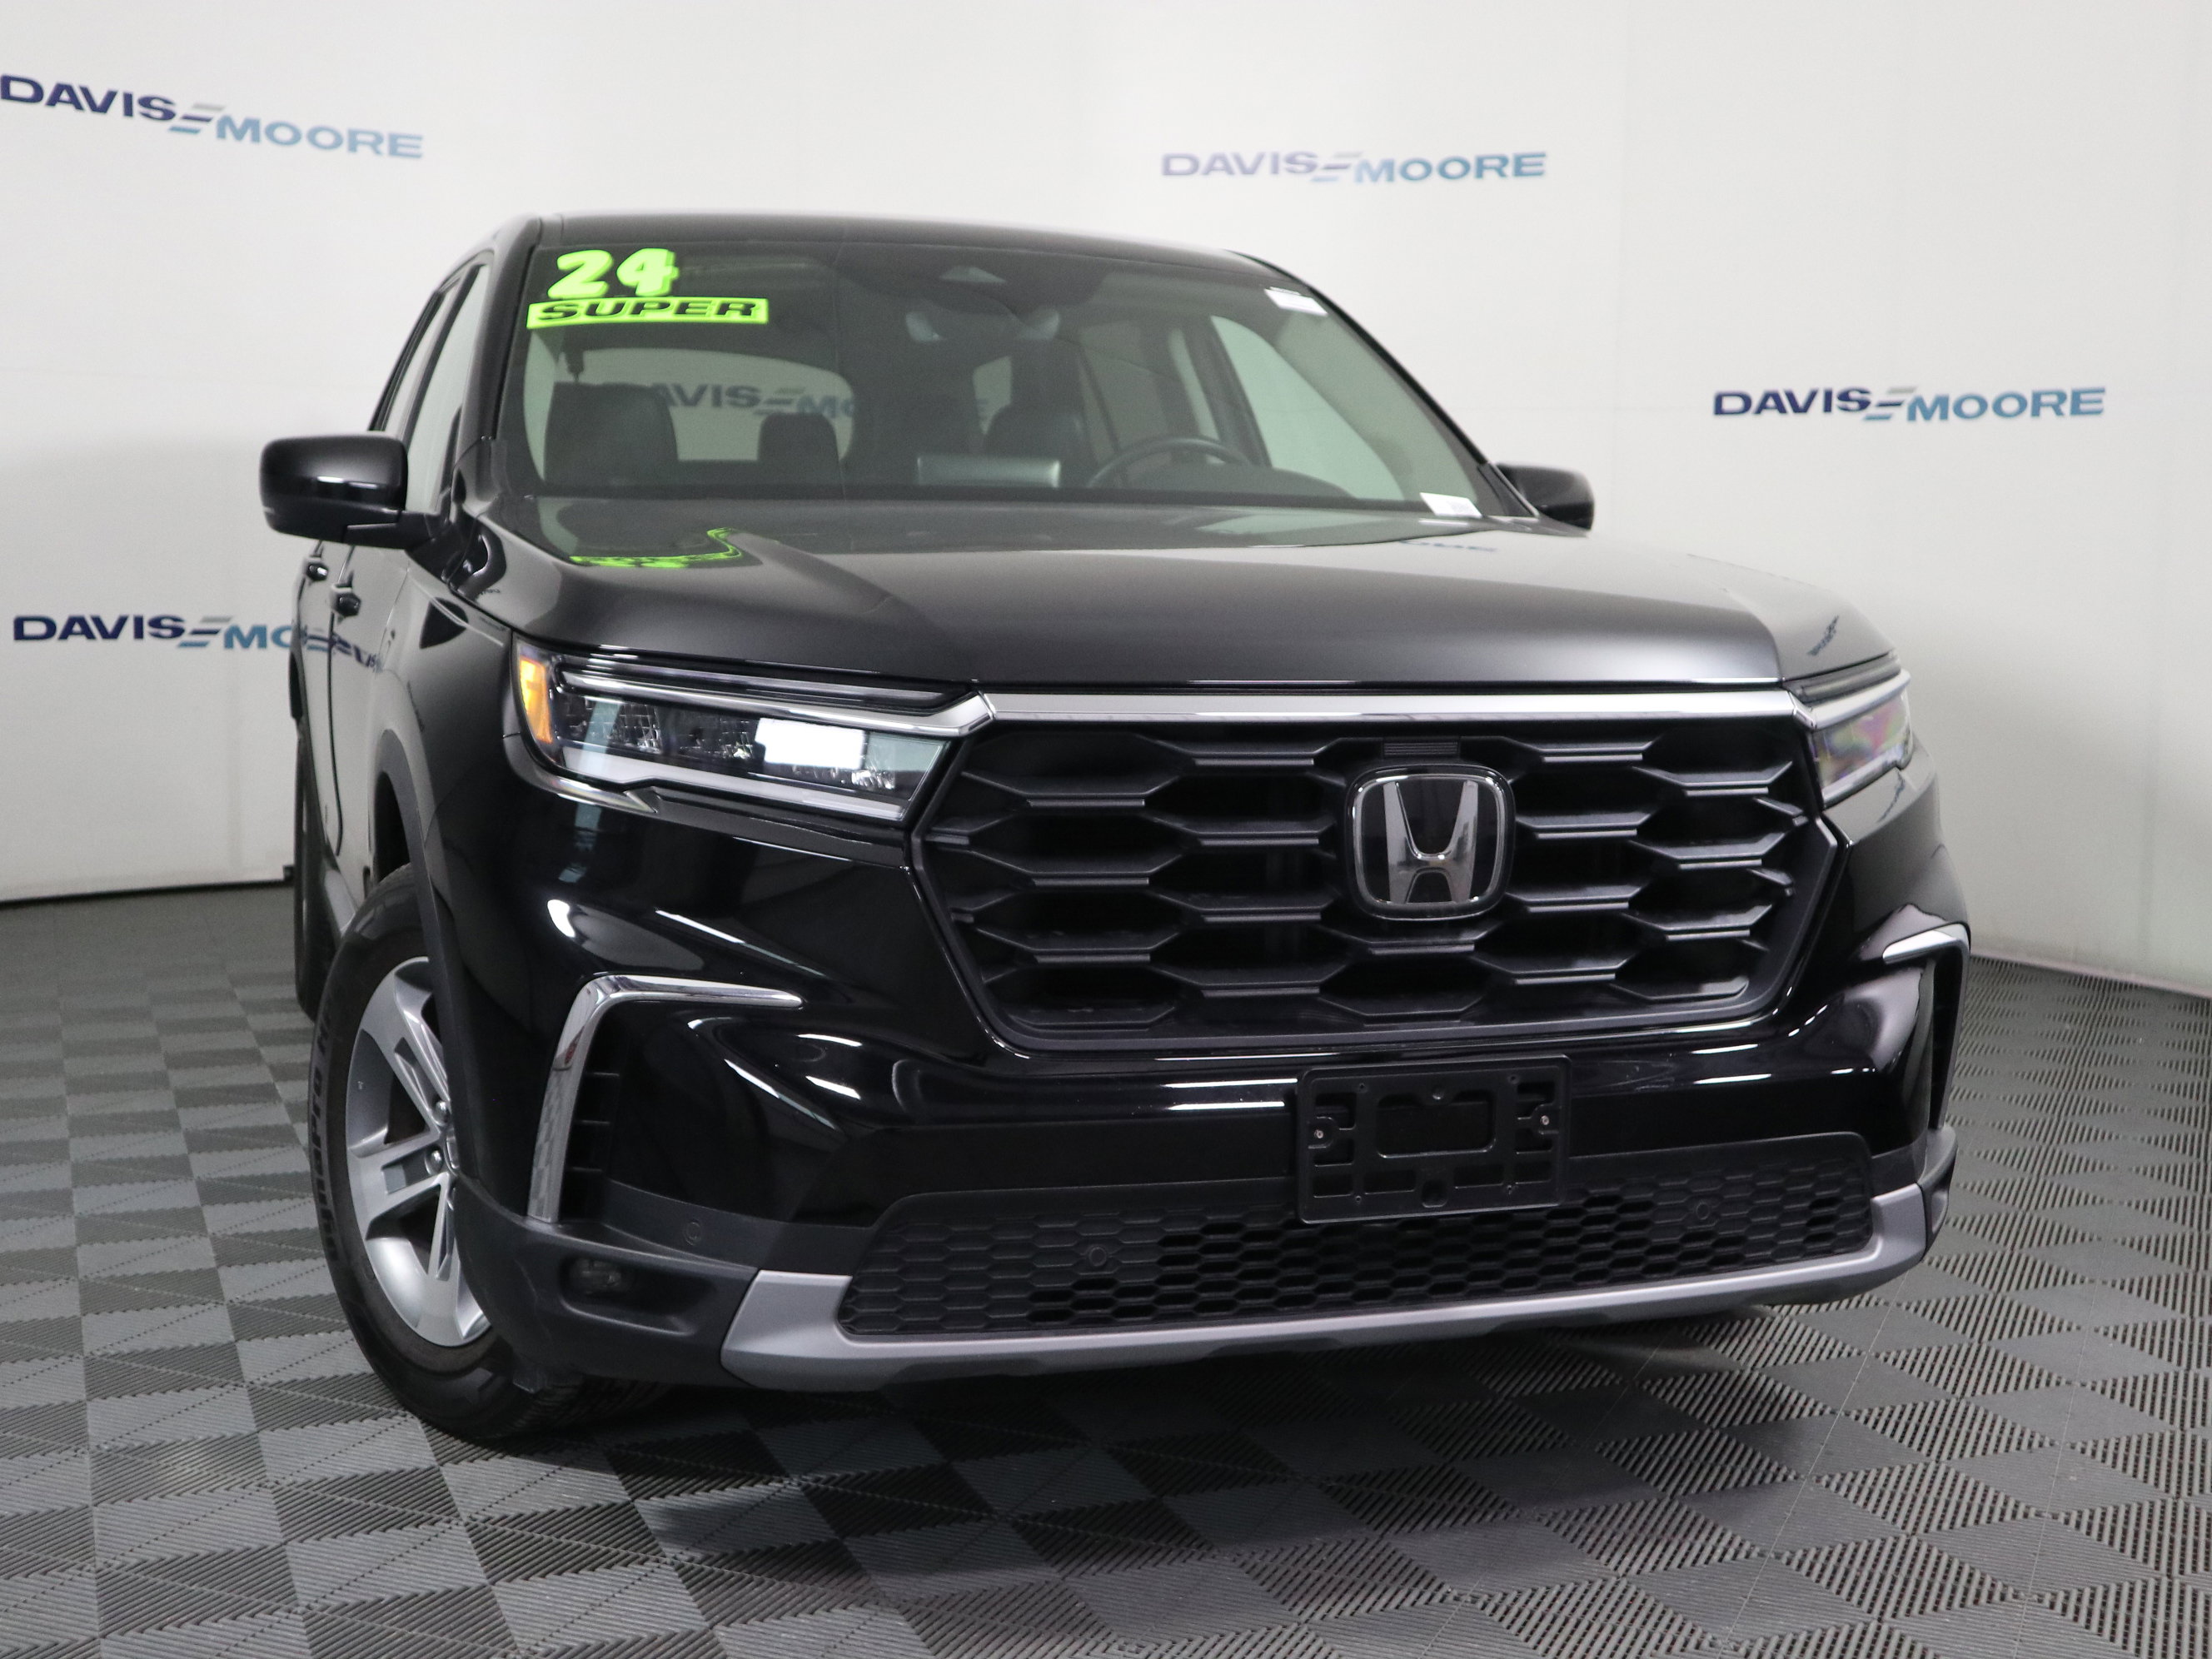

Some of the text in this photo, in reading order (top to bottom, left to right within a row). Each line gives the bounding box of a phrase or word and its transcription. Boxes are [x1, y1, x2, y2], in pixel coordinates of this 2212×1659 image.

[0, 74, 424, 159] DAVIS MOORE
[1161, 151, 1547, 183] DAVIS MOORE
[547, 247, 680, 299] 24
[537, 300, 757, 320] SUPER
[1713, 387, 2106, 422] DAVIS MOORE
[12, 615, 186, 641] DAVIS
